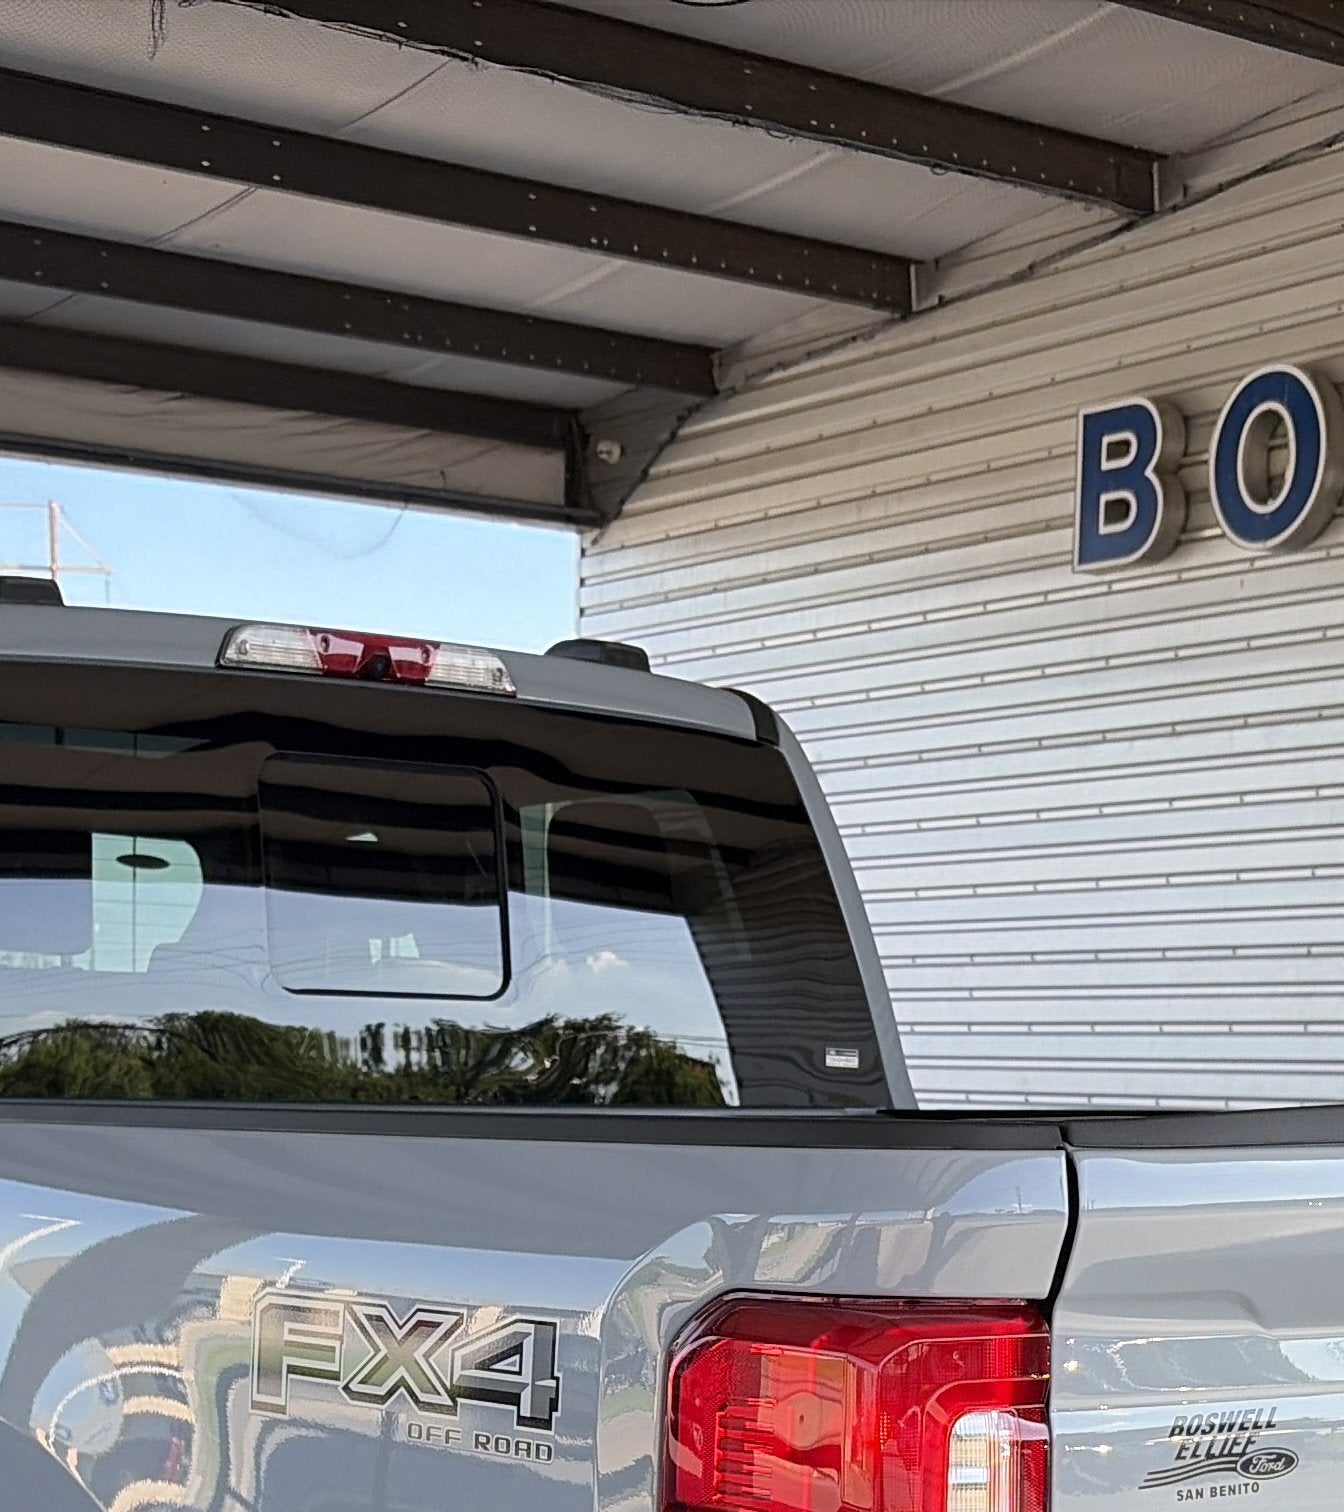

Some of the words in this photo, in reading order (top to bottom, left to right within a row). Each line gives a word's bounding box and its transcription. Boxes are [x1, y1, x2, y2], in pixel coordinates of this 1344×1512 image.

[249, 1287, 562, 1432] FX4
[1168, 1406, 1277, 1437] BOSWELL
[407, 1421, 462, 1446] OFF
[473, 1431, 554, 1464] ROAD
[1248, 1453, 1287, 1476] Ford
[1177, 1488, 1204, 1501] SAN
[1210, 1482, 1260, 1499] BENITO
